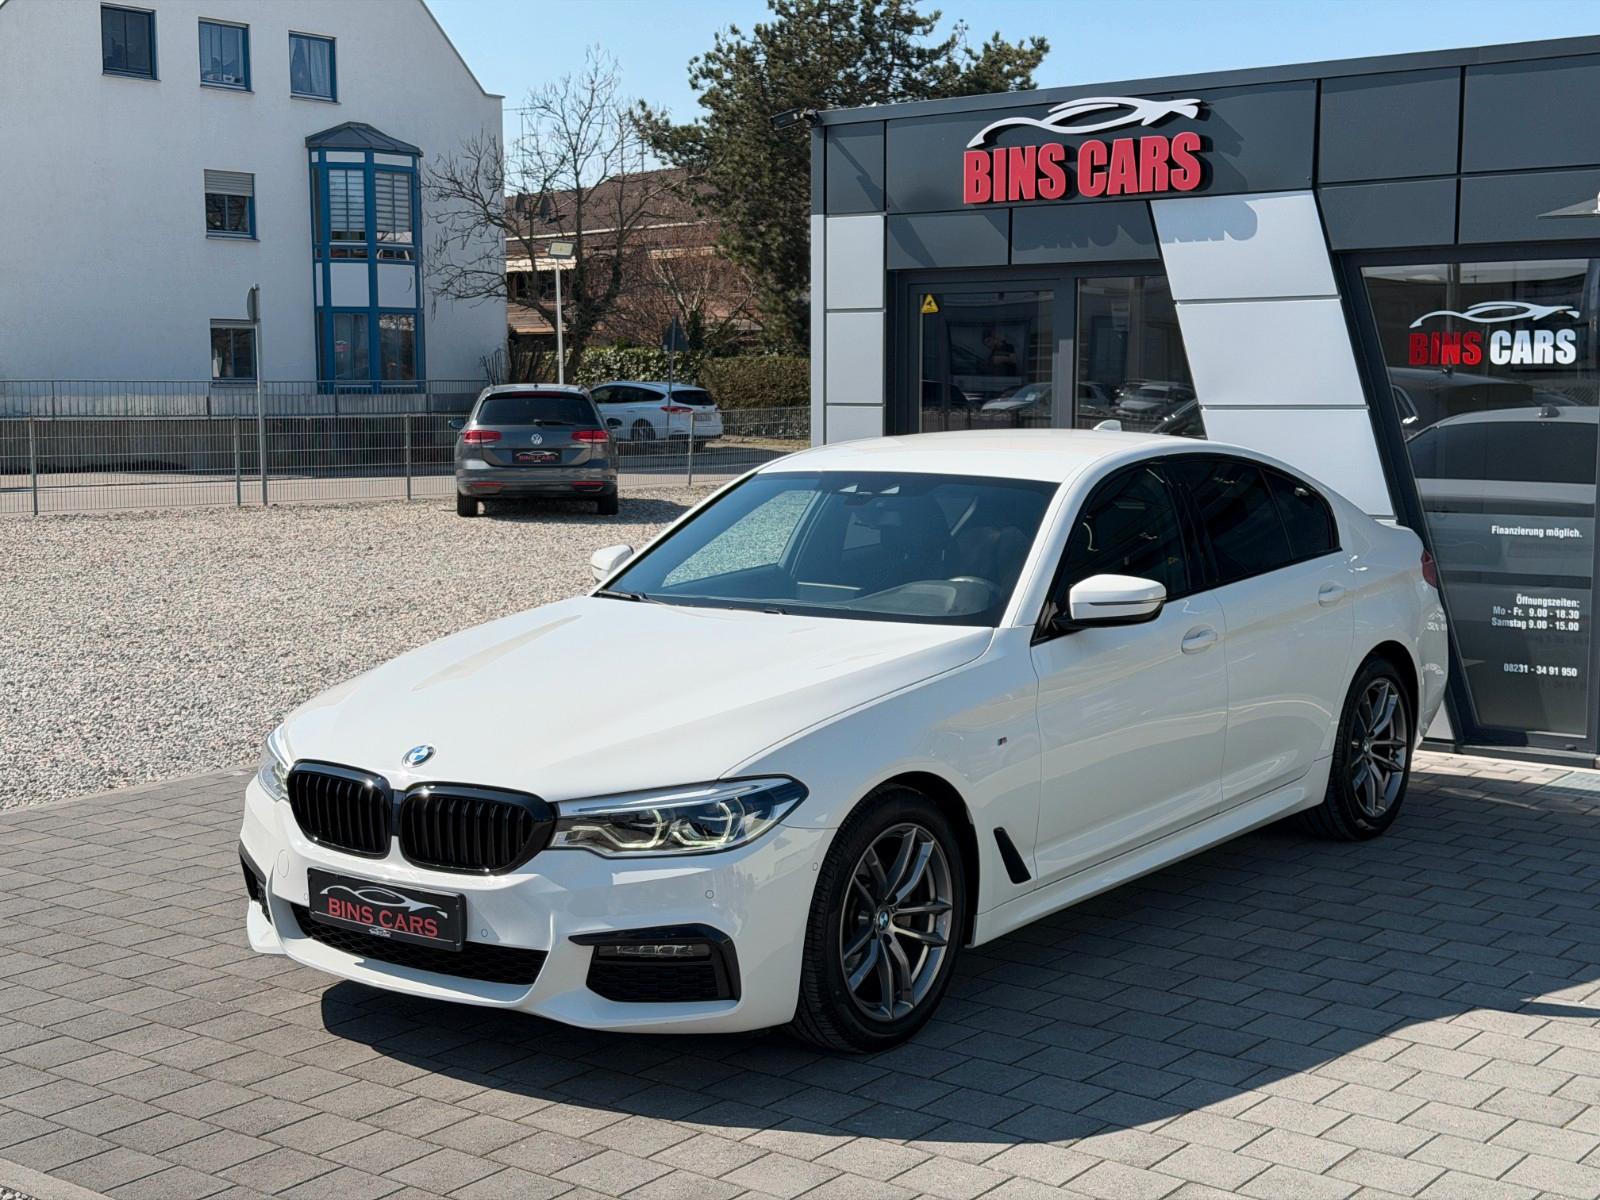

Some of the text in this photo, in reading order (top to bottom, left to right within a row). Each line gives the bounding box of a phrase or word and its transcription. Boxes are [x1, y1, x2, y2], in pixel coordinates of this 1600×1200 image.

[963, 131, 1202, 204] BINS CARS
[1408, 328, 1577, 366] BINS CARS
[1491, 525, 1583, 539] Finanzierung möglich.
[1516, 593, 1581, 608] Öffnungszeiten:
[1492, 606, 1506, 615] Mo
[1513, 606, 1525, 617] Fr.
[1528, 607, 1548, 618] 9.00
[1555, 609, 1580, 620] 18.30
[1491, 617, 1527, 630] Samstag
[1528, 619, 1548, 629] 9.00
[1555, 621, 1580, 631] 15.00
[1503, 663, 1529, 673] 08231
[1536, 665, 1547, 675] 34
[1548, 666, 1559, 676] 91
[1561, 667, 1578, 677] 950
[327, 896, 439, 938] BINS CARS
